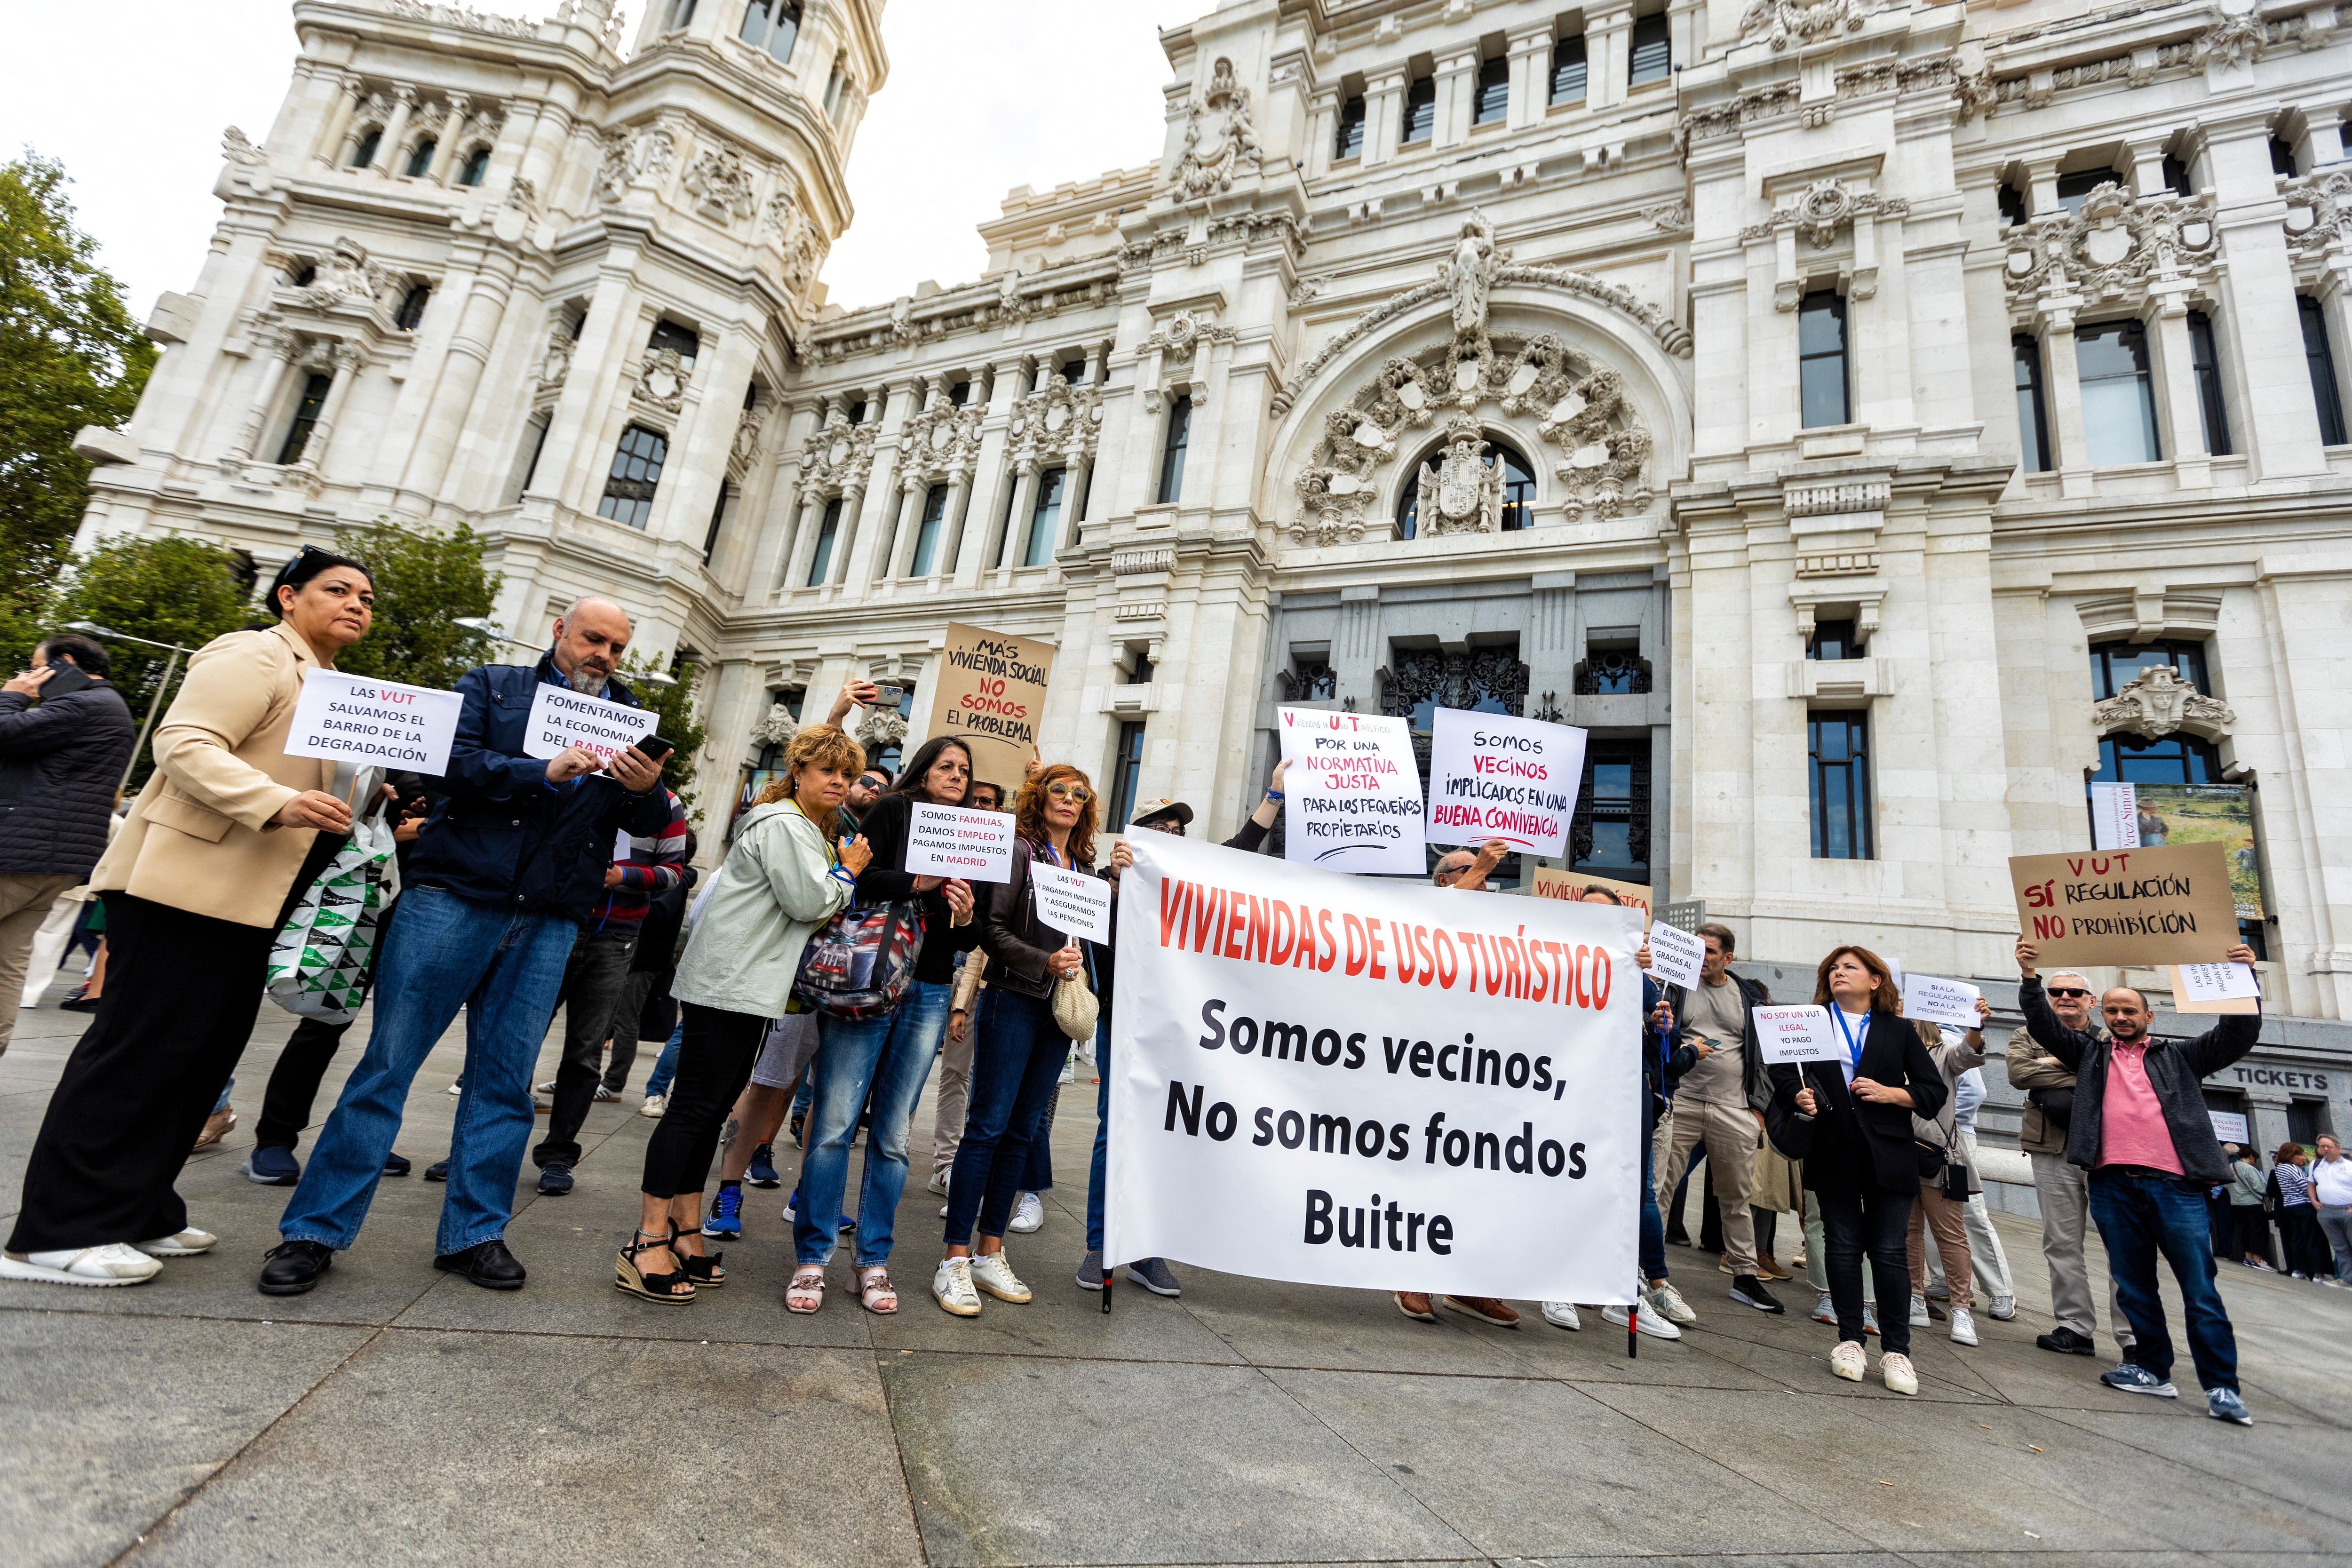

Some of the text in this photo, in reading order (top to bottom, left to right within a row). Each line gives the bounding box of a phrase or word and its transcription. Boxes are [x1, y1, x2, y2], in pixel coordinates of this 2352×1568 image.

[976, 639, 1018, 659] MÁS
[949, 645, 1047, 687] VIVIENDA SOCIAL
[350, 686, 416, 705] LAS VUT
[980, 677, 1005, 697] NO
[328, 702, 425, 726] SALVAMOS EL
[546, 694, 645, 728] FOMENTAMOS
[961, 694, 1027, 718] SOMOS
[323, 719, 421, 742] BARRIO DE LA
[547, 715, 634, 744] LA ECONOMIA
[946, 709, 1032, 744] EL PROBLEMA
[308, 736, 427, 762] DEGRADACIÓN
[543, 732, 568, 748] DEL
[1315, 738, 1380, 751] POR UNA
[1474, 732, 1543, 754] SOMOS
[1307, 753, 1398, 775] NORMATIVA
[1473, 755, 1548, 780] VECINOS
[1325, 774, 1380, 790] JUSTA
[1446, 772, 1566, 812] IMPLICADOS EN UNA
[1303, 796, 1421, 816] PARA LOS PEQUEÑOS
[2119, 787, 2133, 820] Simón
[921, 811, 1004, 828] SOMOS FAMILIAS,
[1307, 818, 1400, 838] PROPIETARIOS
[1434, 805, 1558, 838] BUENA CONVIVENCIA
[919, 826, 954, 836] DAMOS
[958, 830, 996, 841] EMPLEO
[913, 839, 1007, 855] PAGAMOS IMPUESTOS
[946, 856, 986, 867] MADRID
[1057, 875, 1086, 888] LAS VUT
[2024, 872, 2190, 907] SÍ REGULACIÓN
[1042, 885, 1072, 898] PAGAMOS
[1074, 893, 1106, 907] IMPUESTOS
[1048, 908, 1093, 928] LAS PENSIONES
[1050, 899, 1095, 916] ASEGURAMOS
[2033, 909, 2197, 940] NO PROHIBICIÓN
[1160, 877, 1611, 1012] VIVIENDAS DE USO TURÍSTICO
[1651, 937, 1701, 960] COMERCIO FLORECE
[1669, 932, 1694, 946] PEQUEÑO
[1656, 950, 1692, 970] GRACIAS AL
[1657, 964, 1685, 980] TURISMO
[2194, 976, 2203, 987] LAS
[2214, 971, 2227, 992] PAGAN
[1918, 991, 1966, 1003] REGULACIÓN
[1917, 1007, 1965, 1019] PROHIBICIÓN
[1199, 999, 1566, 1101] Somos vecinos,
[2233, 1067, 2328, 1090] TICKETS
[1164, 1080, 1587, 1180] No somos fondos
[1303, 1189, 1454, 1255] Buitre
